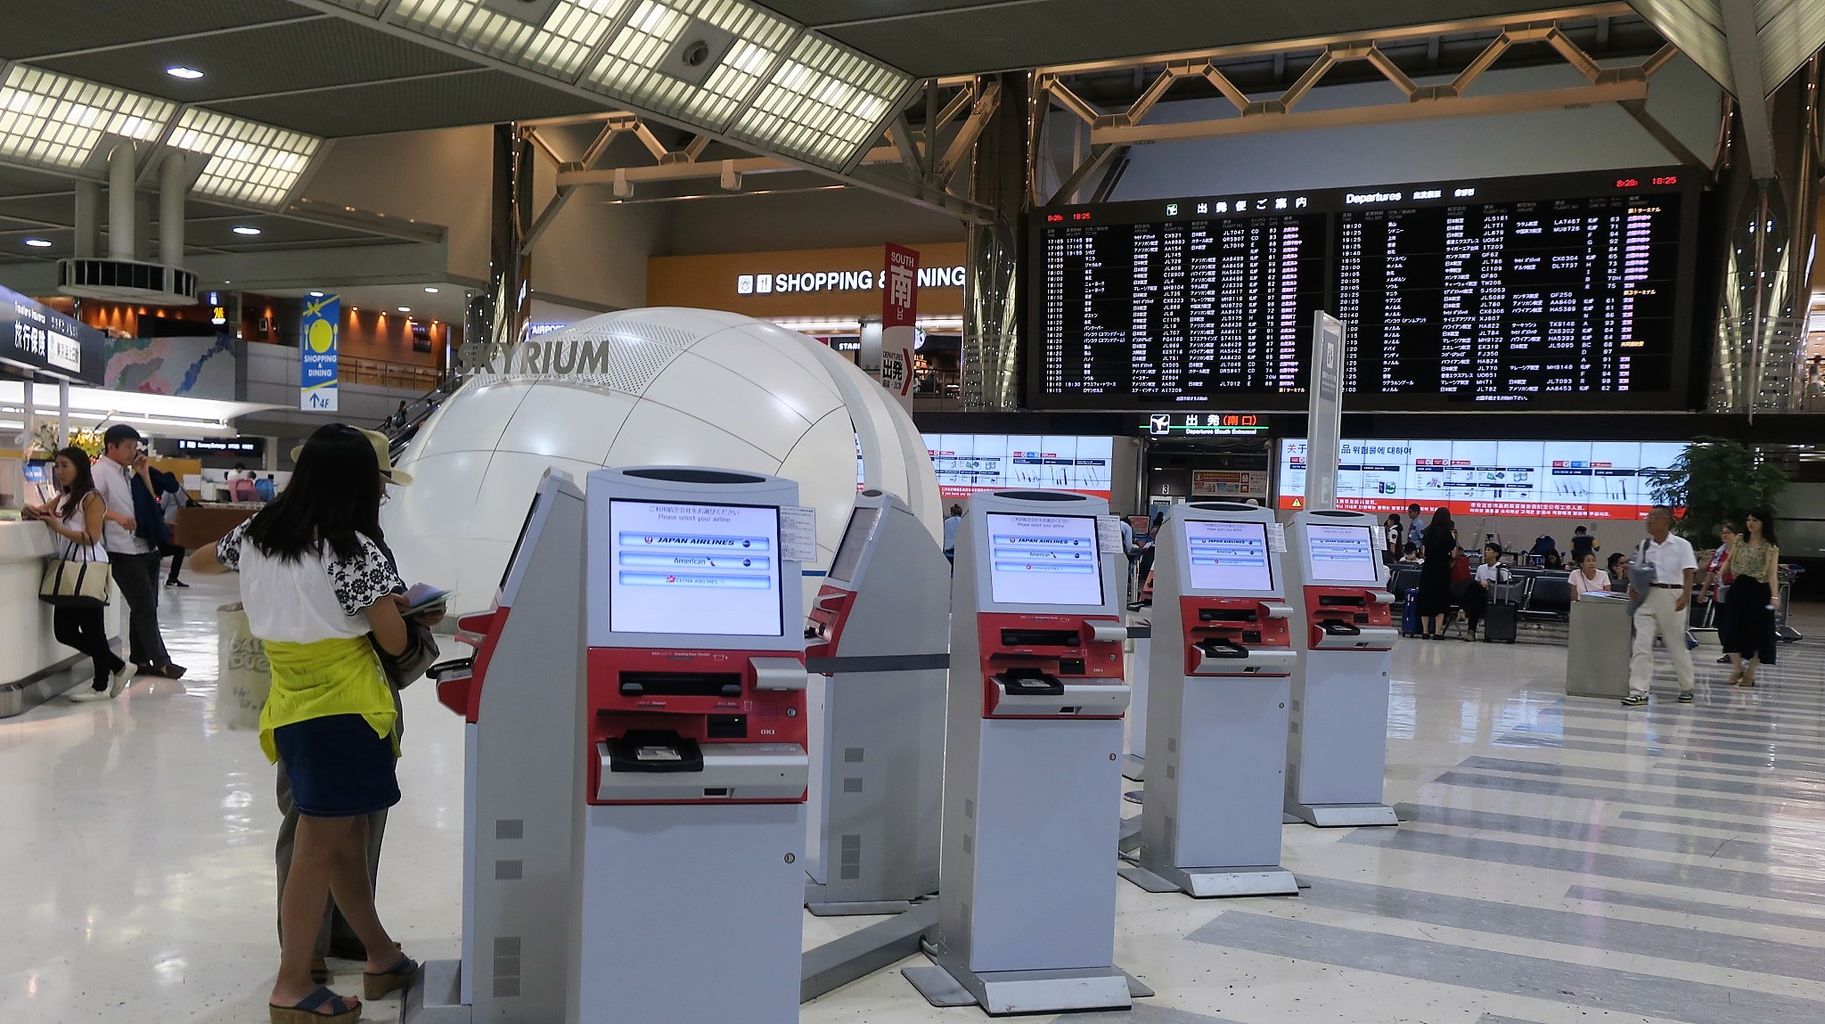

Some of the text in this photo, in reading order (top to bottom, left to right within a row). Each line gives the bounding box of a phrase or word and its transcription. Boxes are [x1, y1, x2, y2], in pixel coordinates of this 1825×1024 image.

[1652, 176, 1677, 185] 18:25
[1346, 191, 1402, 205] Departures
[1073, 212, 1091, 220] 18:25
[890, 251, 914, 268] SOUTH
[775, 270, 873, 292] SHOPPING
[917, 266, 966, 287] NING
[304, 354, 337, 363] SHOPPING
[457, 340, 610, 375] SKYRIUM
[308, 369, 332, 377] DINING
[882, 358, 903, 381] 出発
[319, 398, 330, 409] 4F
[1185, 428, 1213, 436] Departures
[689, 538, 735, 546] AIRLINES
[673, 557, 706, 565] American
[228, 653, 269, 673] DUC
